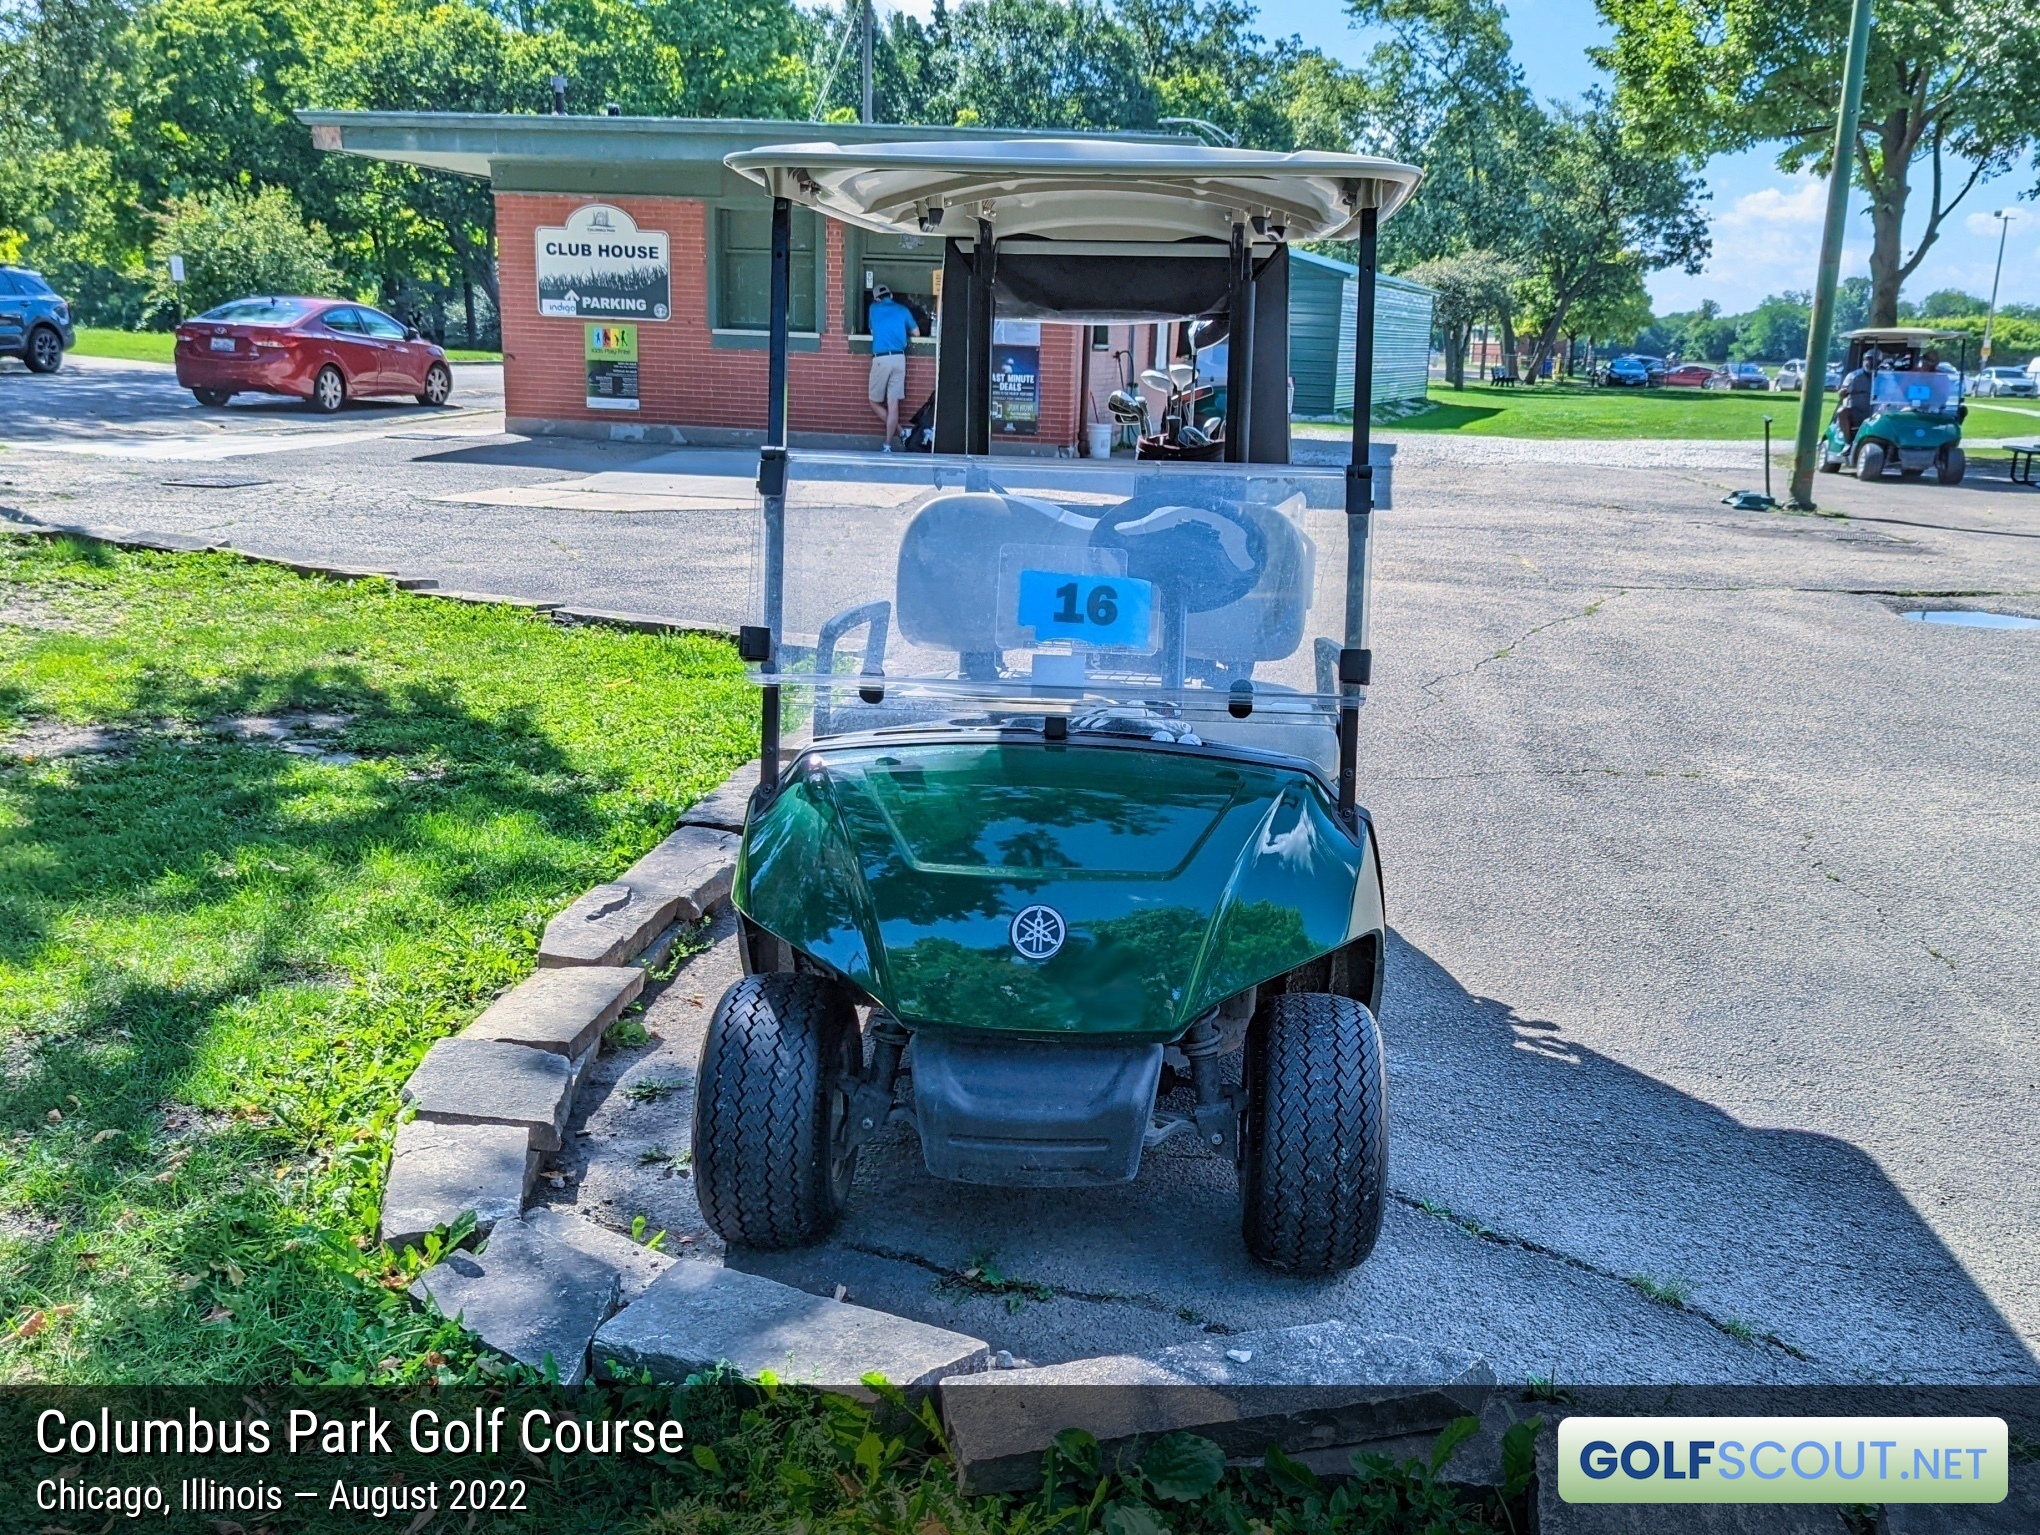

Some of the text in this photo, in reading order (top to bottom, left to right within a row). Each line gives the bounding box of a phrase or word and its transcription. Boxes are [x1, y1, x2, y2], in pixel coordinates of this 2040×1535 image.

[546, 242, 659, 260] CLUB HOUSE
[549, 302, 576, 313] indigo
[582, 296, 647, 311] PARKING
[992, 373, 1035, 384] AST MINUTE
[999, 382, 1022, 392] DEALS
[1053, 582, 1118, 626] 16
